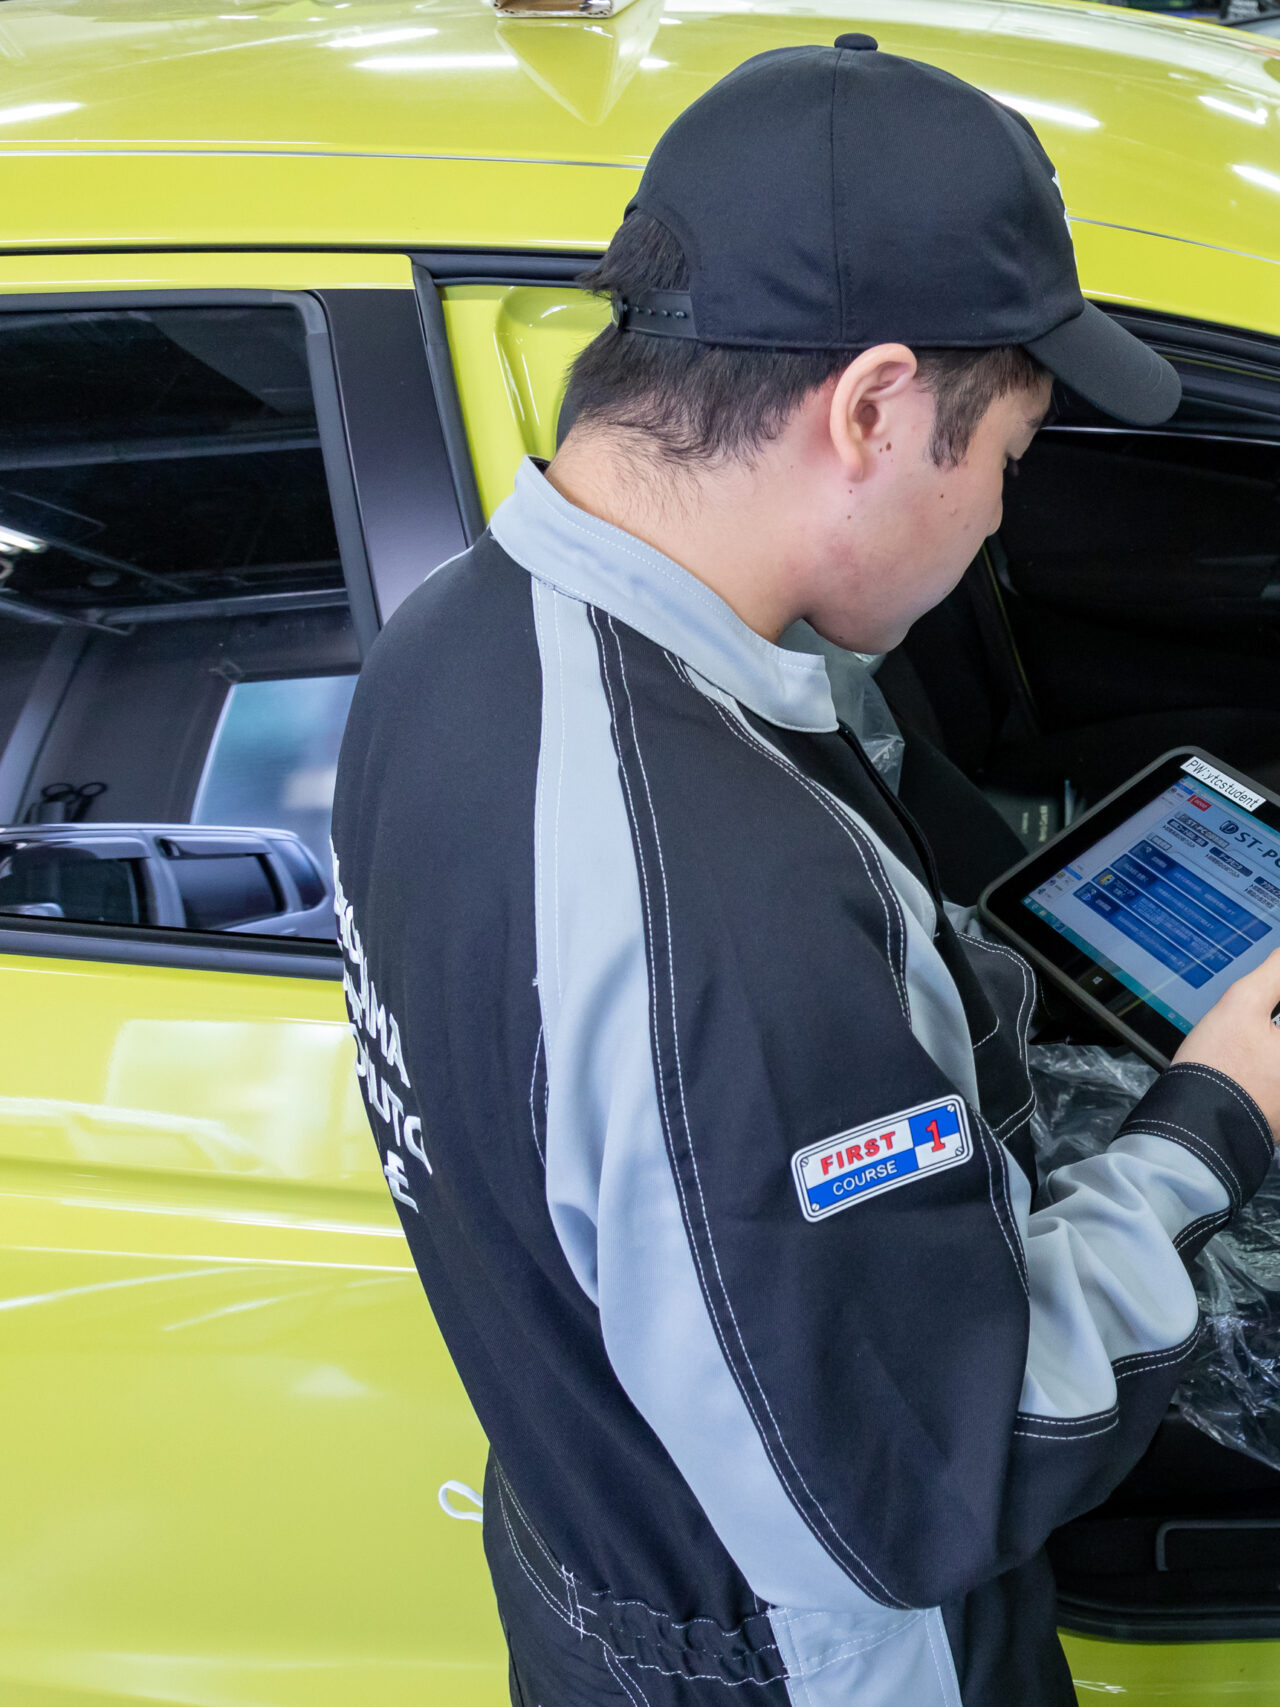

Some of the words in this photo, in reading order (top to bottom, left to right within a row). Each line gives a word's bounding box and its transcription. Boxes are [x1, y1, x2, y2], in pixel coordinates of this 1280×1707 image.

[1186, 760, 1260, 808] PW:ytcstudent
[820, 1131, 896, 1176] FIRST
[925, 1119, 946, 1153] 1
[832, 1159, 898, 1196] COURSE
